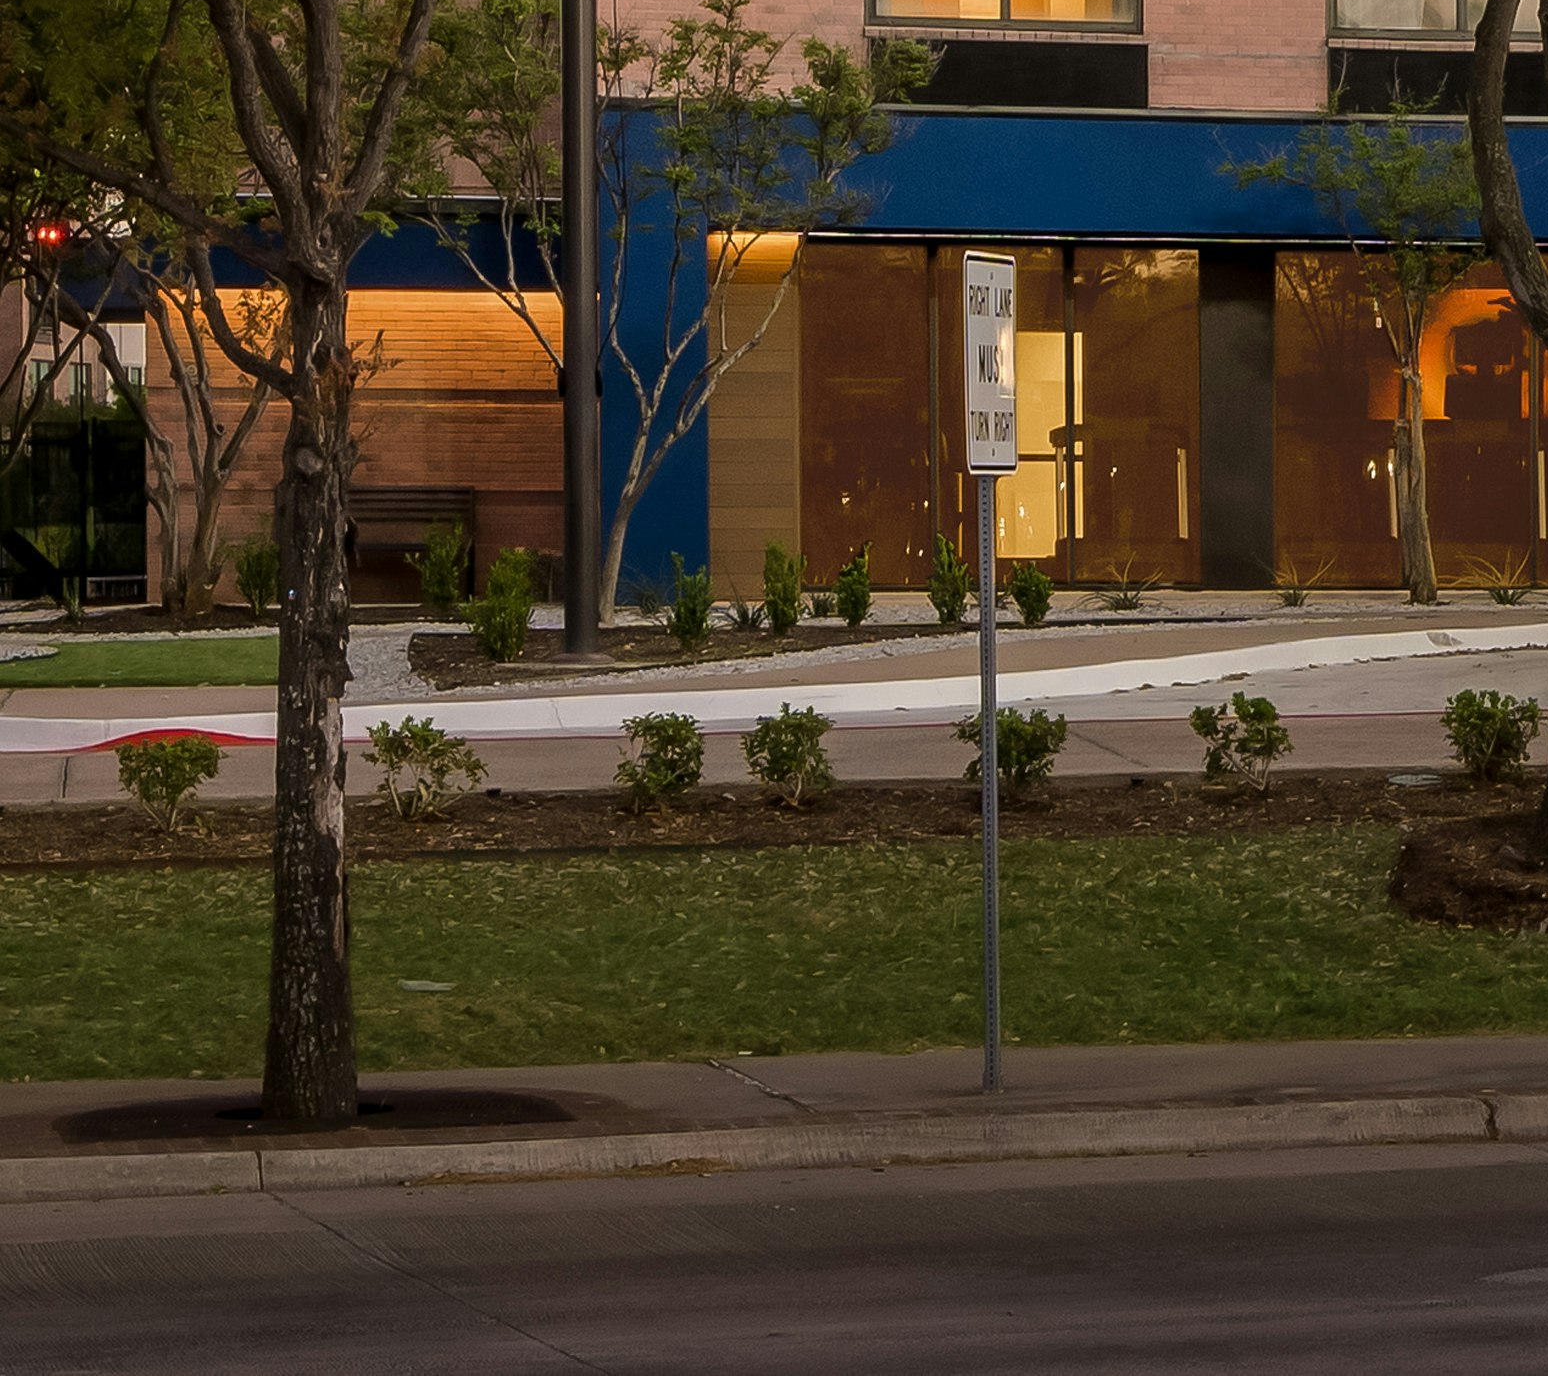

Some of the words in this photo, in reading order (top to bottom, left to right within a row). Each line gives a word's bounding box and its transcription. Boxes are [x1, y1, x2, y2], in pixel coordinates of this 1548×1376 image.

[969, 284, 990, 317] RIGHT
[994, 287, 1012, 318] LANE
[970, 410, 990, 442] TURN
[994, 411, 1014, 442] RIGHT
